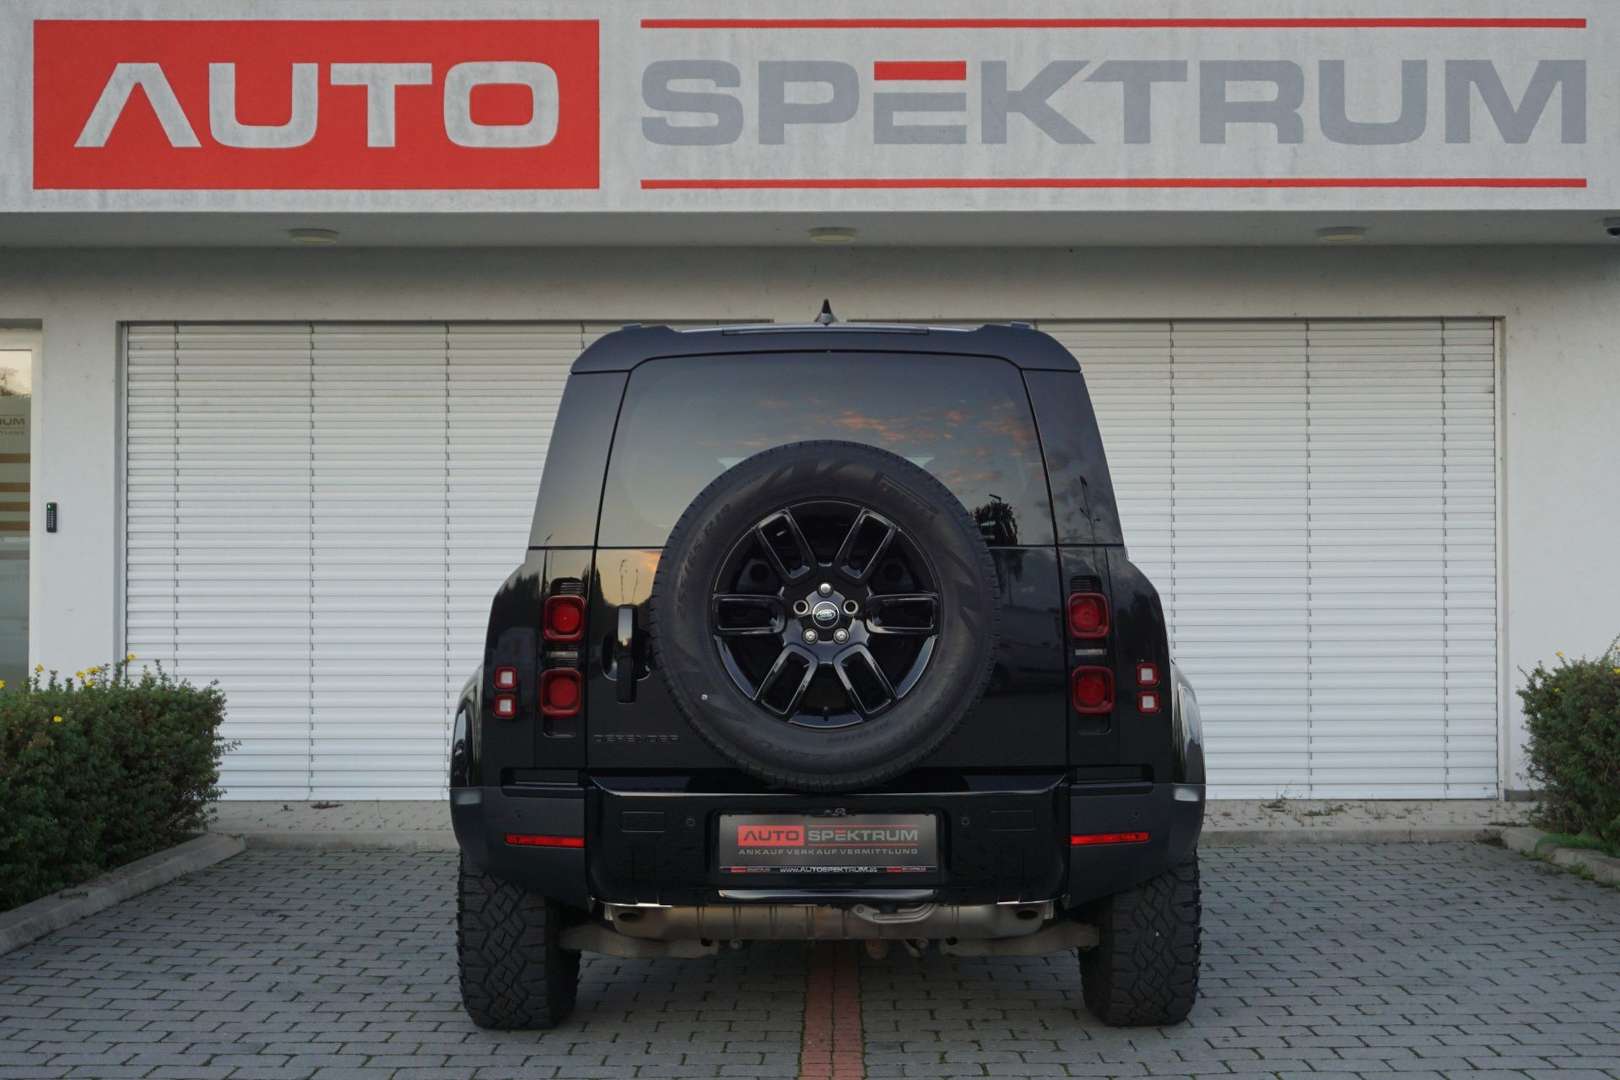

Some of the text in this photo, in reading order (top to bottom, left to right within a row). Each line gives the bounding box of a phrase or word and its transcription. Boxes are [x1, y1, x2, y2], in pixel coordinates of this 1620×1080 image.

[74, 59, 1587, 149] AUTO SPEKTRUM
[743, 828, 918, 841] AUTO SPEKTRUM
[738, 848, 918, 856] ANKAUF VERKAUF VERMITTLUNG
